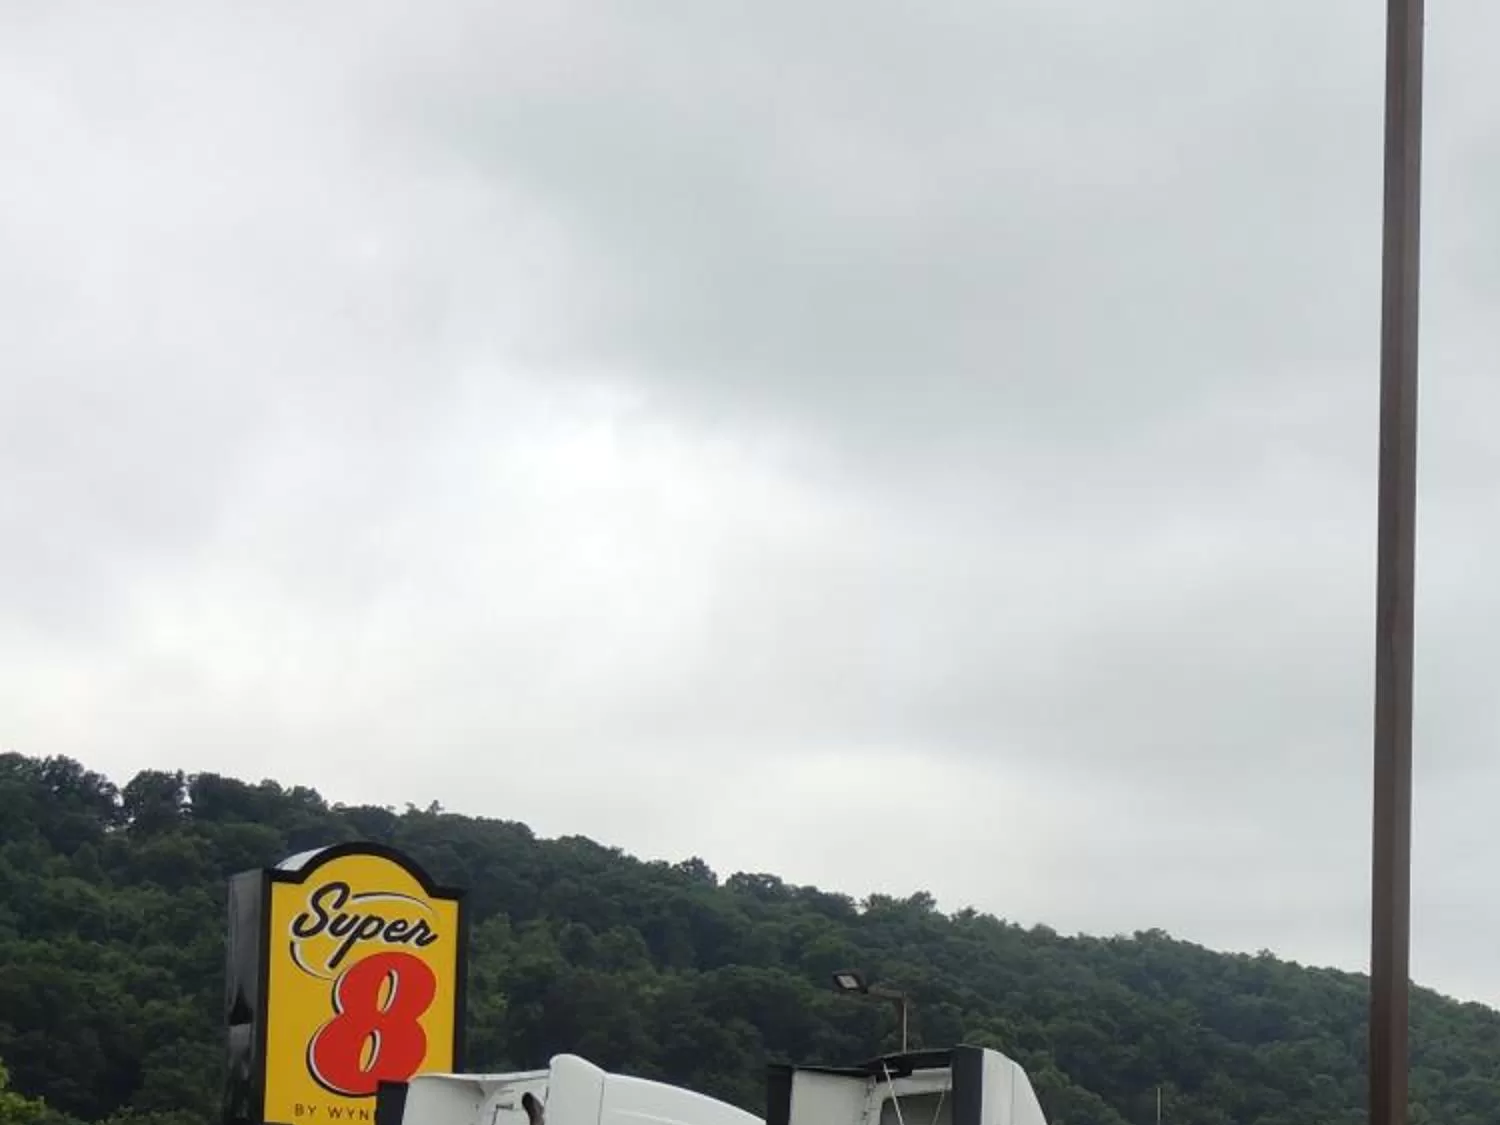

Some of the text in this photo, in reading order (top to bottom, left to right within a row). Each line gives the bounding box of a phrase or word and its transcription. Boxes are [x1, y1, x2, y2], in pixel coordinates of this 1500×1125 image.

[293, 881, 439, 969] Super
[306, 951, 437, 1098] 8
[294, 1103, 376, 1121] BY WYN
